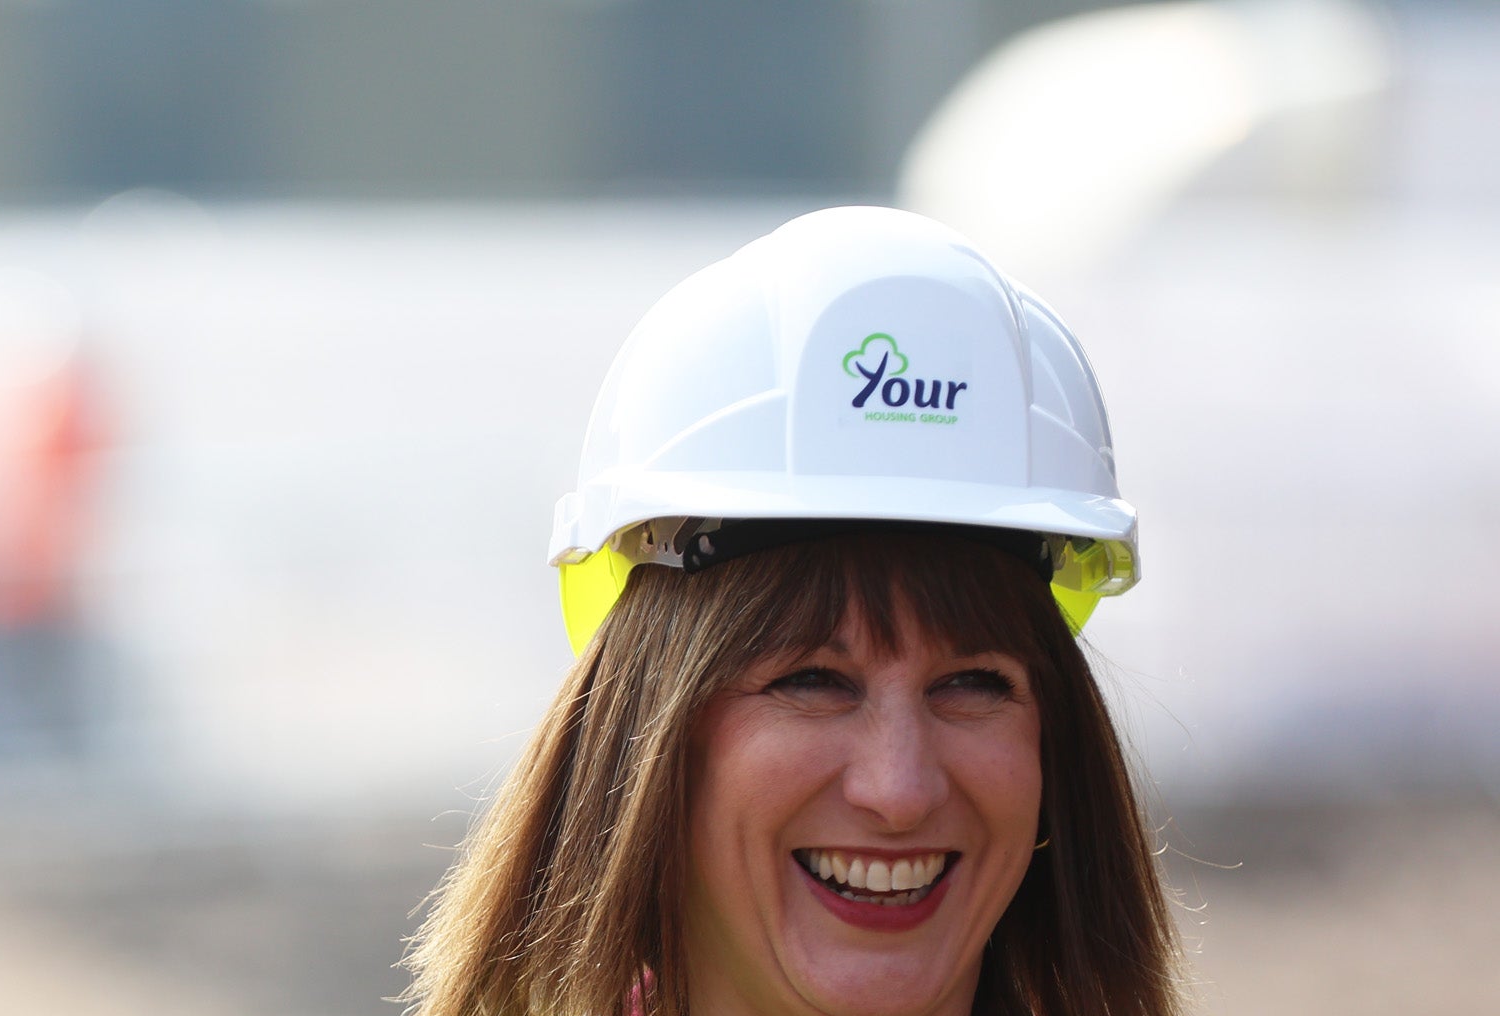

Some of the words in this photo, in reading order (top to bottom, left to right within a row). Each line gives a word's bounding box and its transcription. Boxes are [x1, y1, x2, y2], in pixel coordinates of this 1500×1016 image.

[852, 350, 968, 410] Your
[864, 411, 917, 423] HOUSING
[919, 413, 958, 425] GROUP
